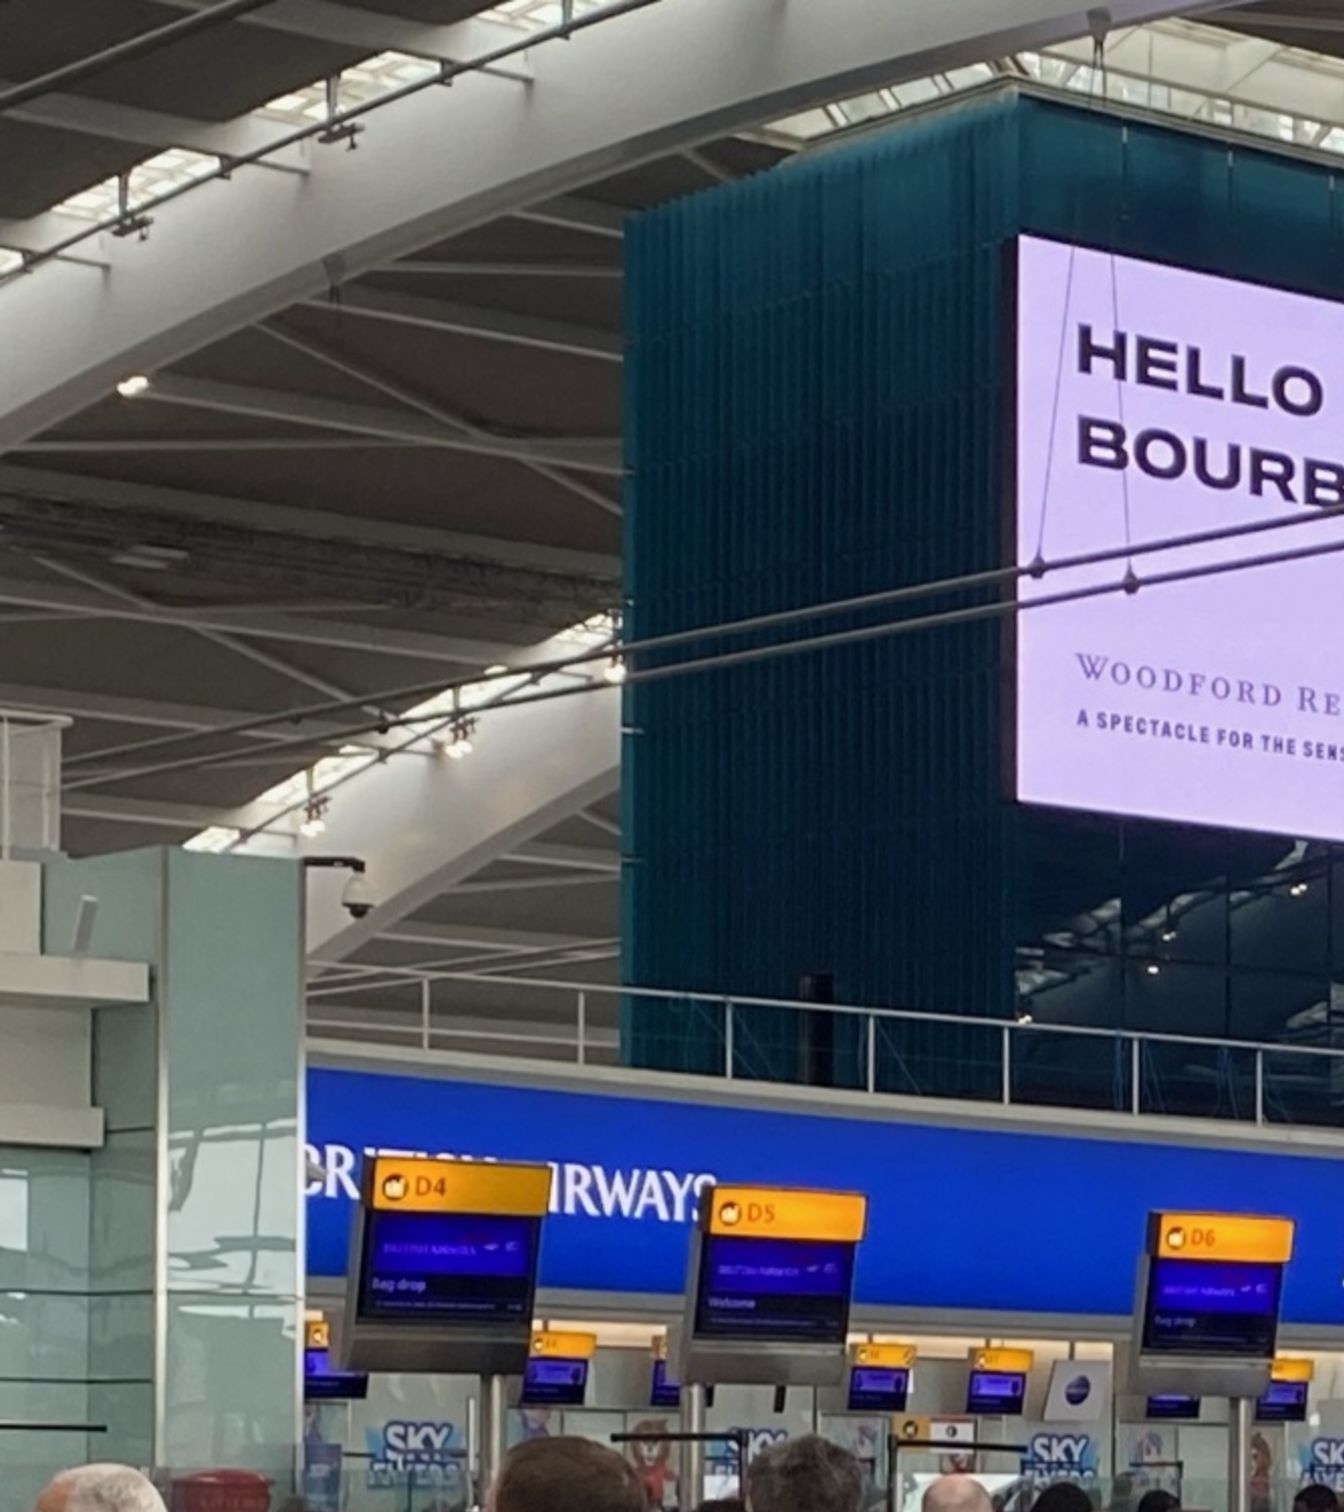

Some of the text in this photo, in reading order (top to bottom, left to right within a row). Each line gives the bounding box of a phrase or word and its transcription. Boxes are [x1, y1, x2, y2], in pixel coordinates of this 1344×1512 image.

[1078, 323, 1324, 417] HELLO
[1076, 653, 1282, 706] WOODFORD
[1077, 709, 1089, 727] A
[1096, 711, 1210, 744] SPECTACLE
[1217, 728, 1253, 750] FOR
[1261, 734, 1296, 756] THE
[414, 1175, 446, 1197] D4
[547, 1162, 717, 1222] IRWAY
[746, 1203, 775, 1223] D5
[1190, 1228, 1216, 1247] D6
[385, 1423, 452, 1452] SKY
[1033, 1436, 1088, 1463] SKY
